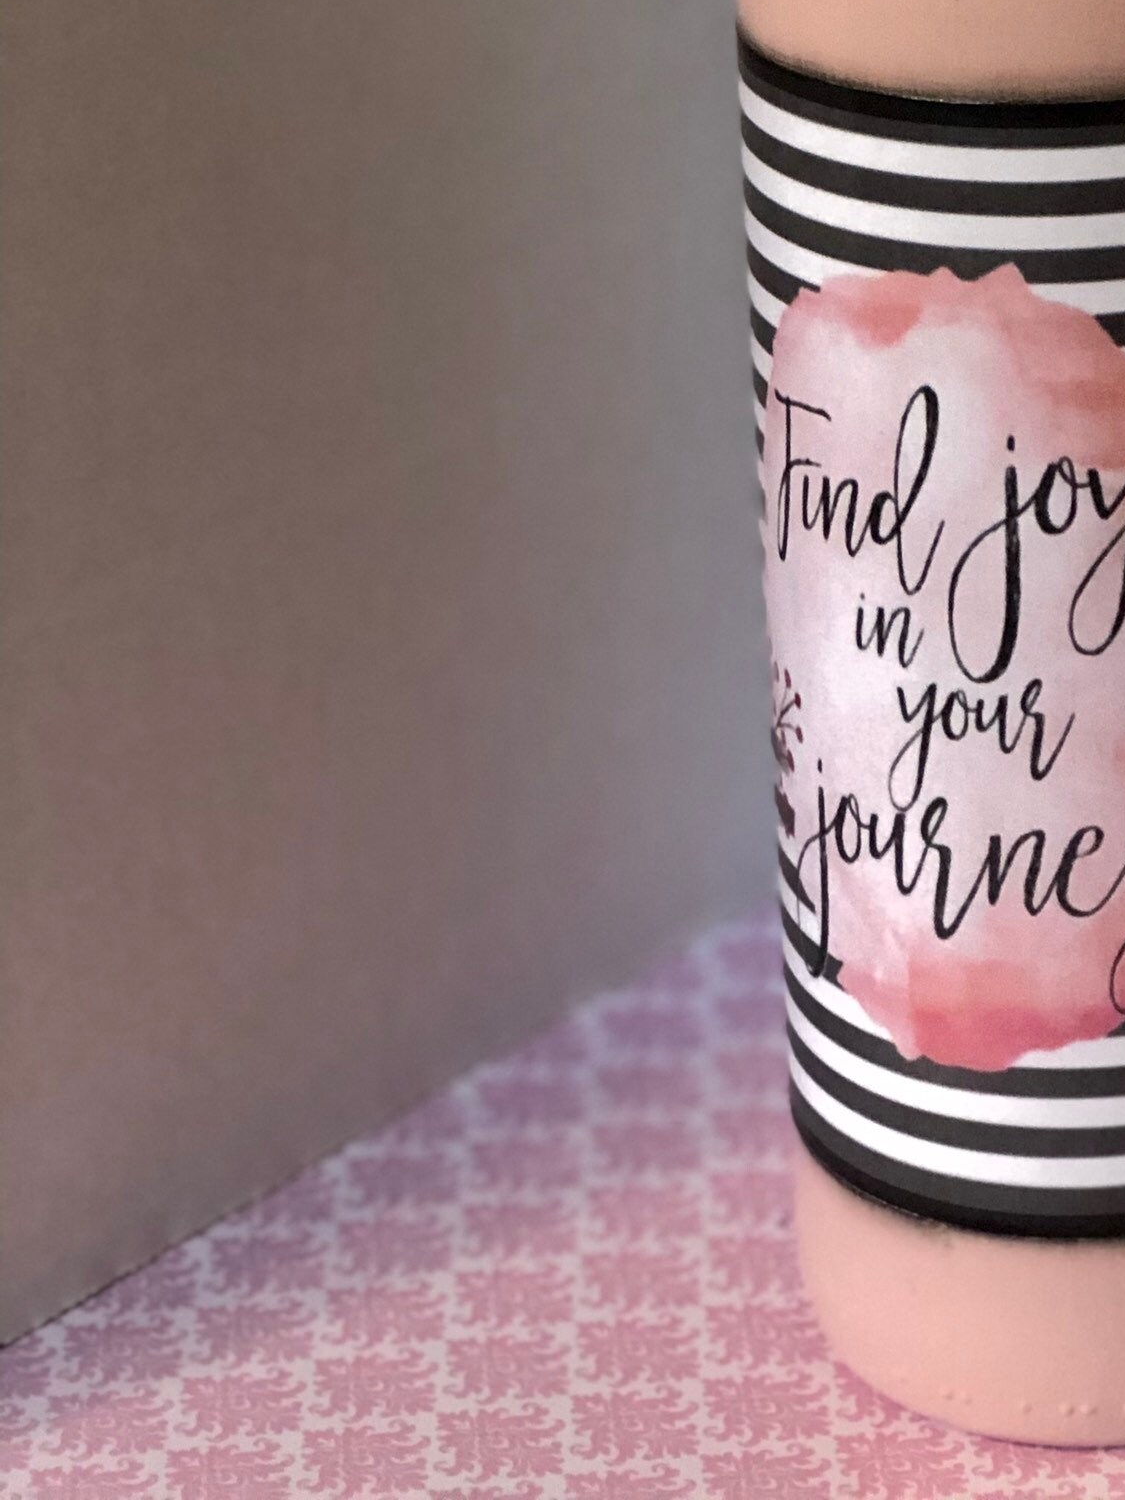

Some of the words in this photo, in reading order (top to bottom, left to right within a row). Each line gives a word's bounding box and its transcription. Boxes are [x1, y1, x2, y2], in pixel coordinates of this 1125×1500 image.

[774, 384, 944, 596] Find
[855, 592, 924, 668] in
[888, 677, 1075, 812] your
